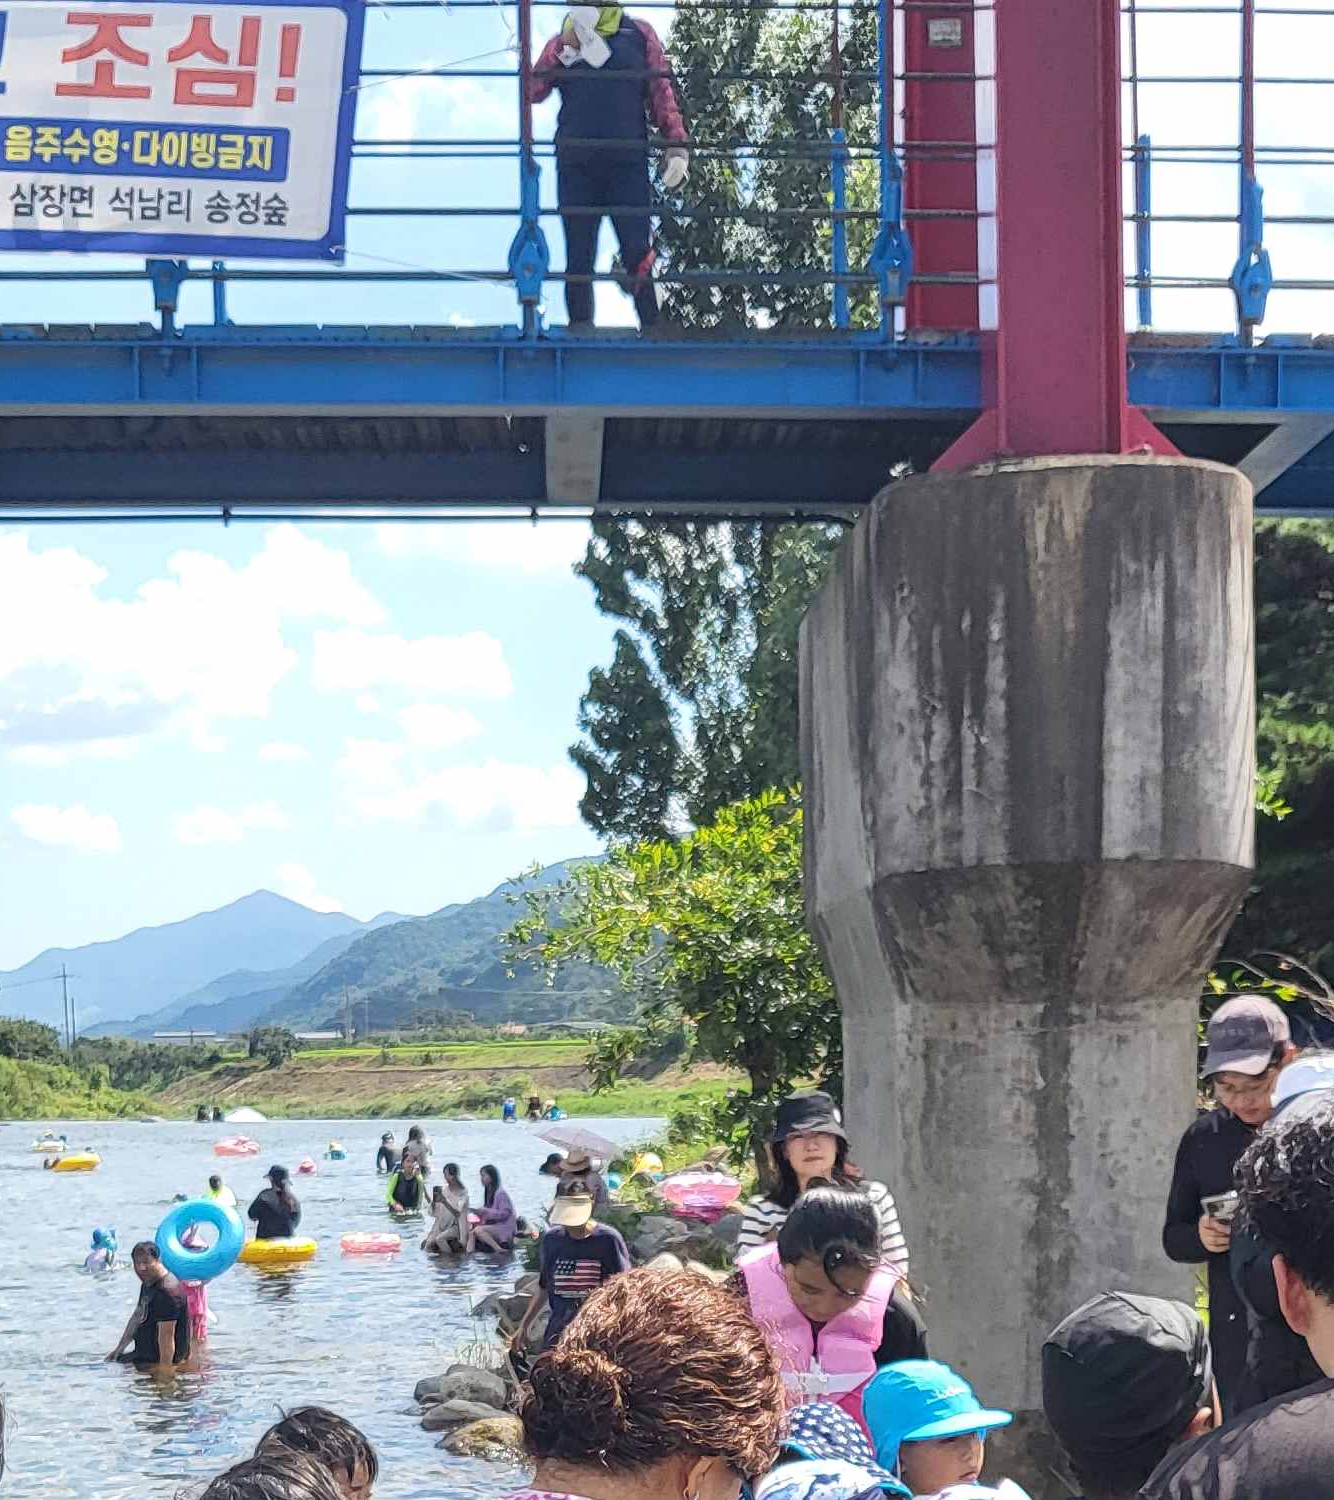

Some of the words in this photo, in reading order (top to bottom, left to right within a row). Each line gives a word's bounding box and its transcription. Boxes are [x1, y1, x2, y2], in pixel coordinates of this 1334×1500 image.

[55, 12, 301, 108] 조심!
[10, 183, 94, 219] 삼장면
[109, 187, 192, 222] 석남리
[205, 191, 289, 226] 송정숲
